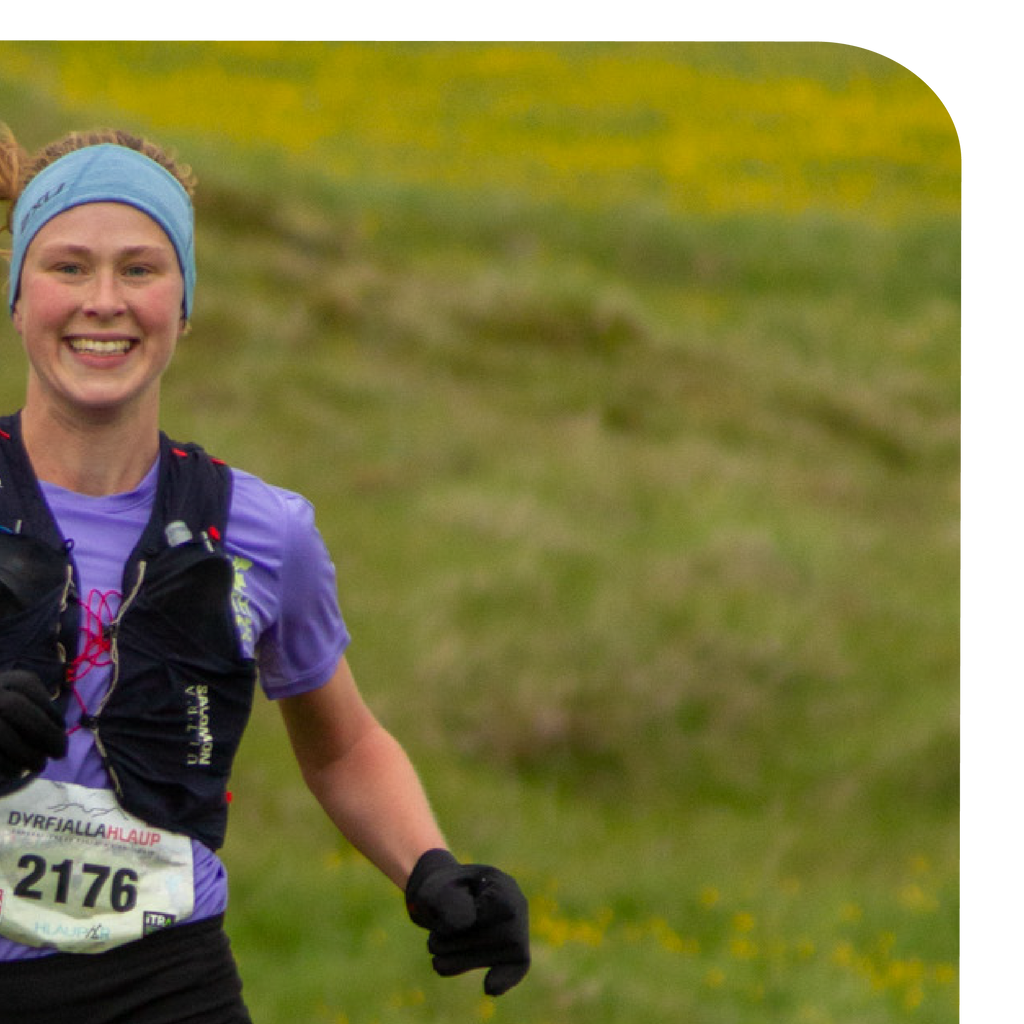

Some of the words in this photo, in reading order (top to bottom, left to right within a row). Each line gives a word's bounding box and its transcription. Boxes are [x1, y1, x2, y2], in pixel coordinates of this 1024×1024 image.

[196, 685, 214, 765] SALOMON
[7, 810, 162, 848] DYRFJALLAHLAUP
[13, 854, 139, 913] 2176
